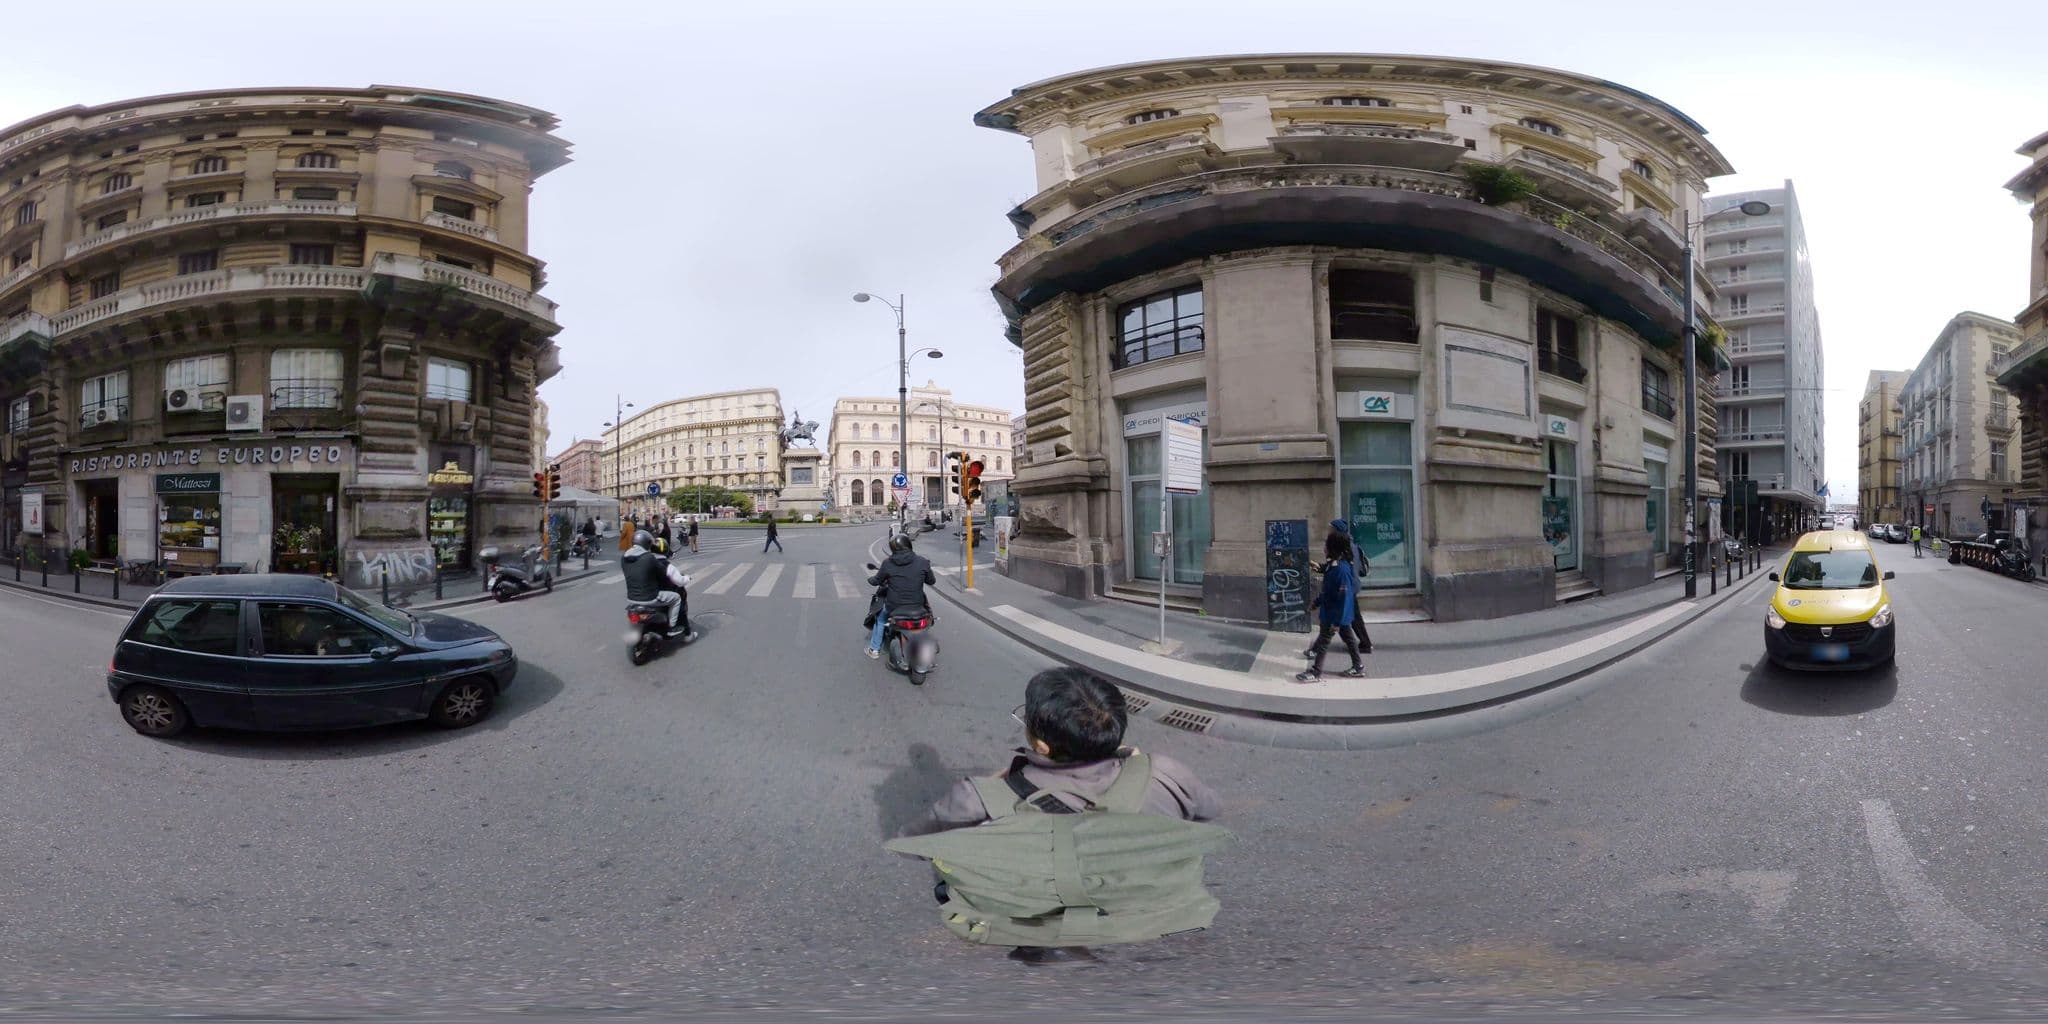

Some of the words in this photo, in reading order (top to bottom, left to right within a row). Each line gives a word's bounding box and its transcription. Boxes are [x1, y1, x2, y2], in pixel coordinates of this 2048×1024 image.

[1137, 417, 1163, 426] CREDI
[71, 448, 202, 473] RISTORANTE
[217, 446, 341, 465] EUROPEO
[163, 476, 212, 489] Mattozzi
